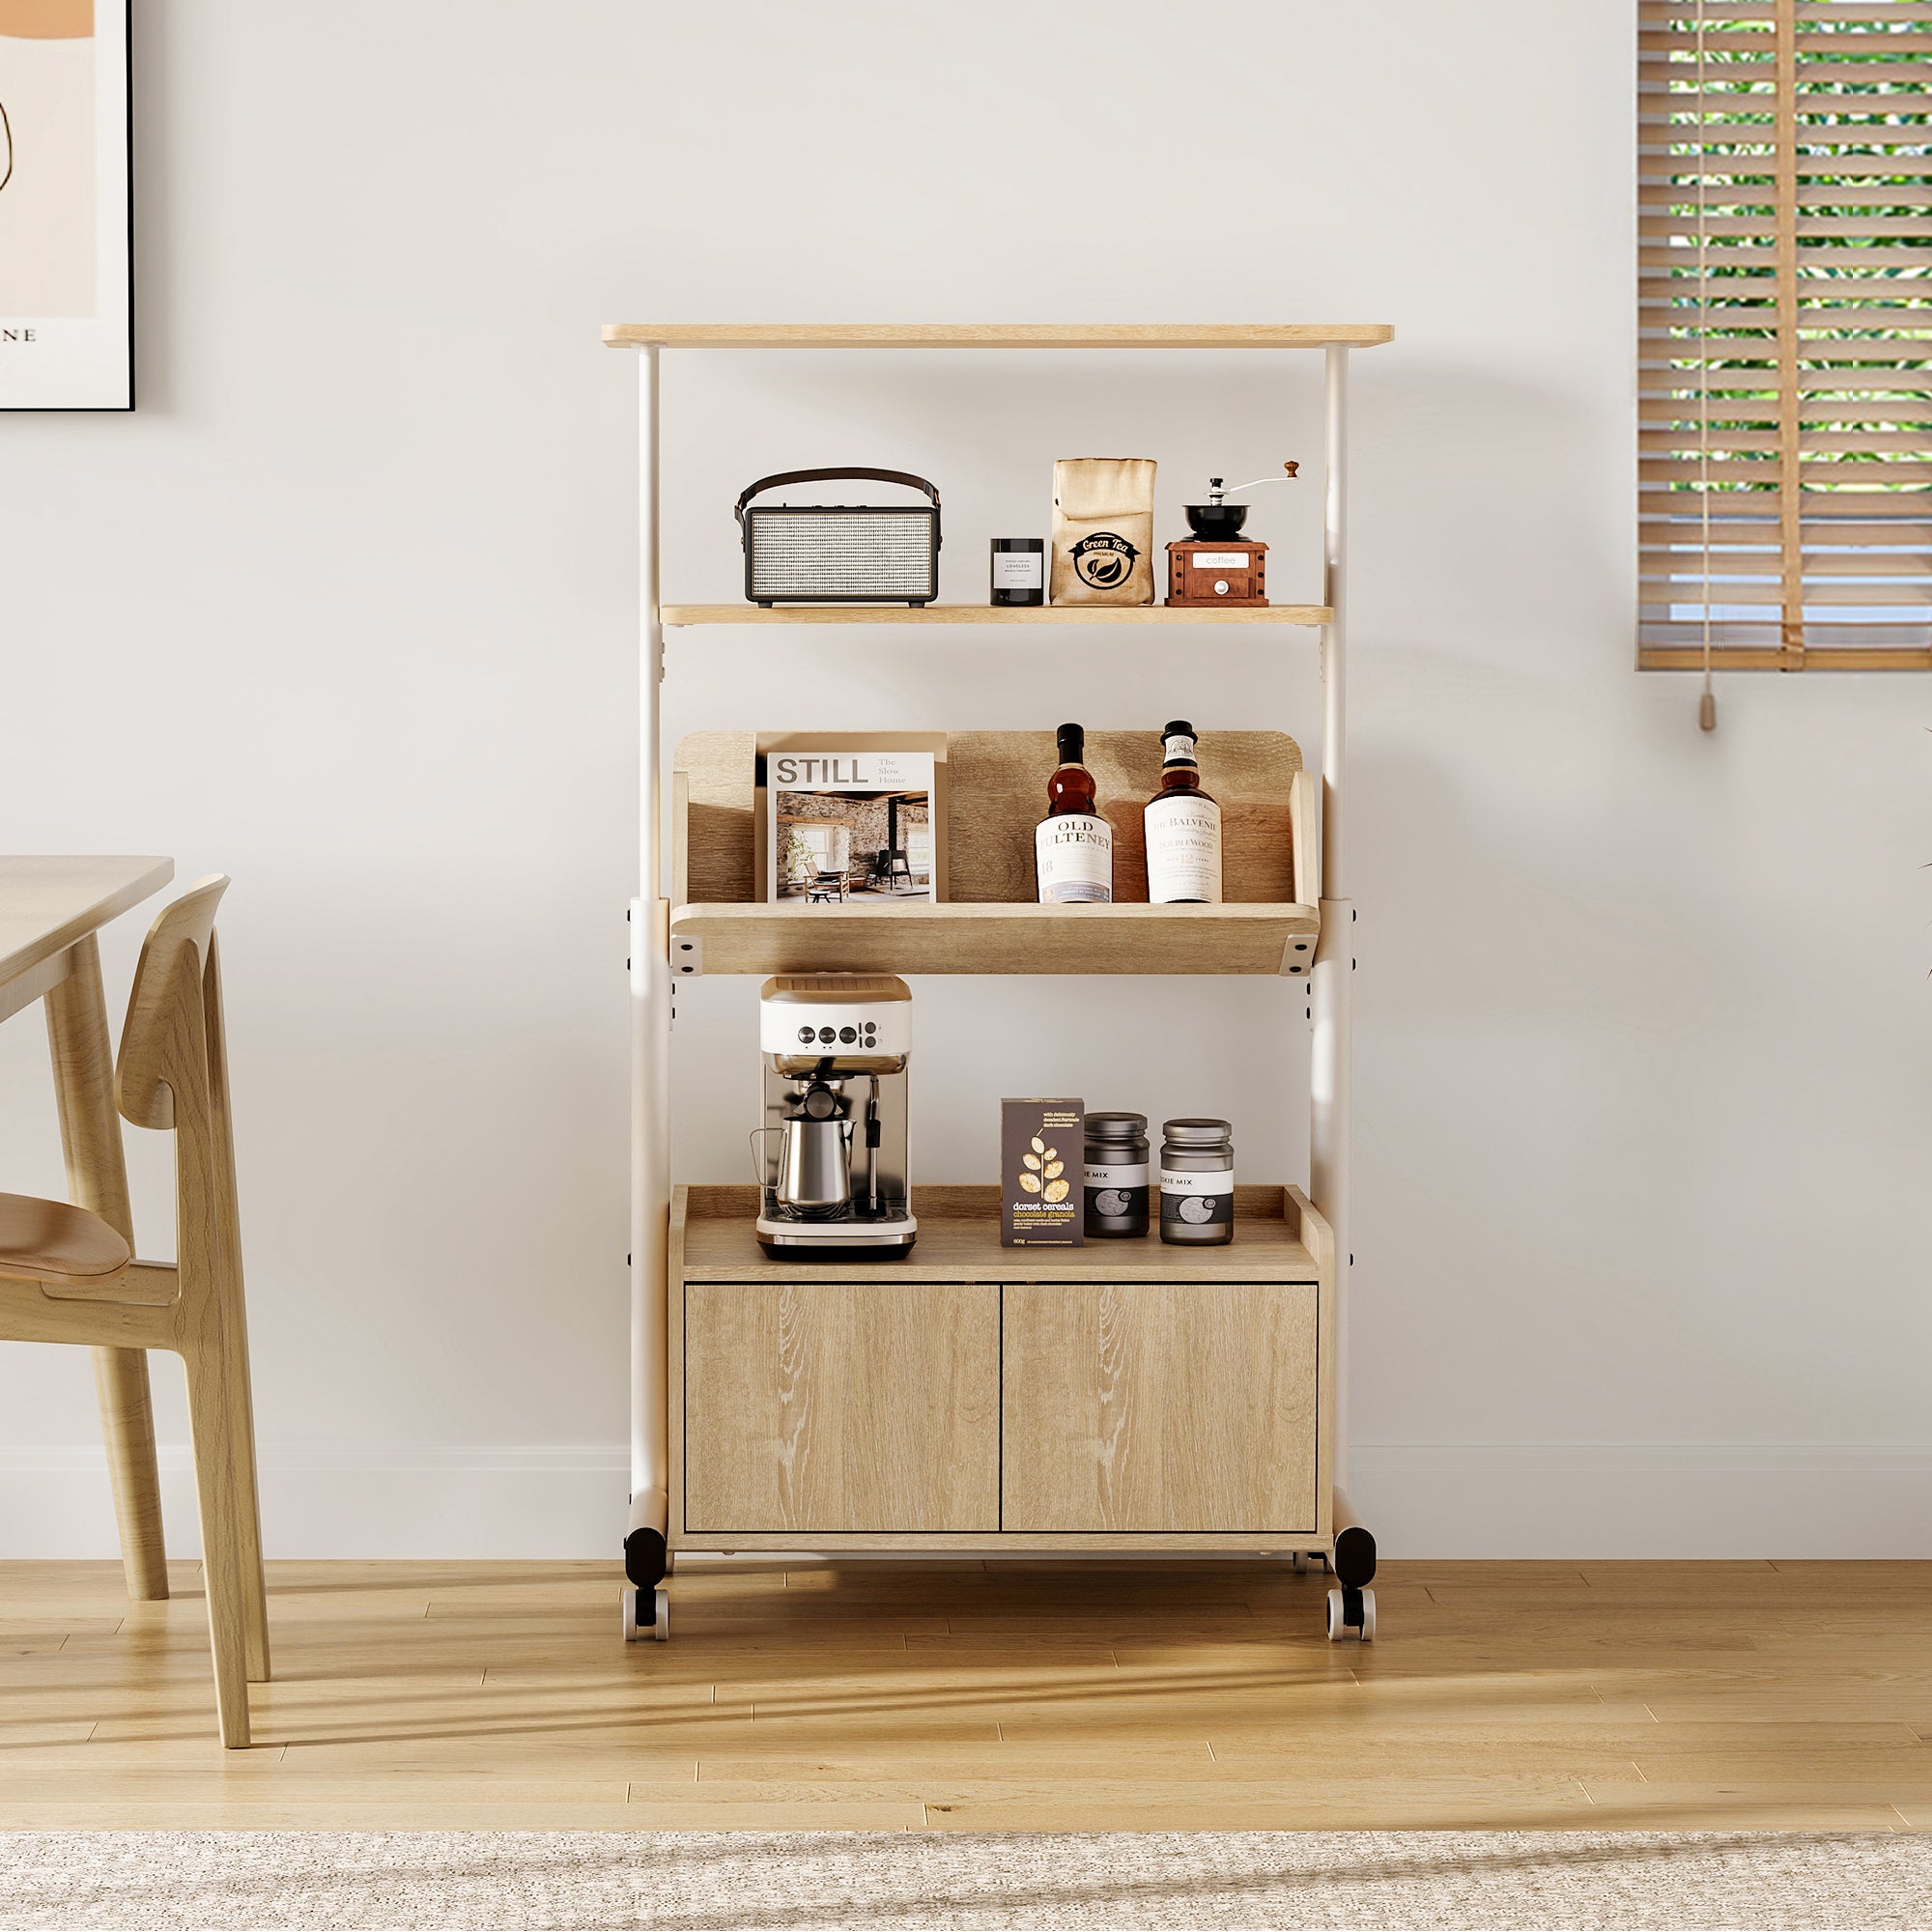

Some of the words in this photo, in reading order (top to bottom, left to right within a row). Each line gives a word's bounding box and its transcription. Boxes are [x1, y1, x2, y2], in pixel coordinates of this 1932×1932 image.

[1082, 540, 1109, 551] Green
[1112, 538, 1128, 553] Tea
[1206, 556, 1236, 565] coffee
[776, 758, 868, 783] STILL
[1058, 821, 1094, 832] OLD
[1039, 832, 1110, 850] PULTENEY
[1013, 1202, 1041, 1211] dorset
[1042, 1202, 1074, 1211] cereals
